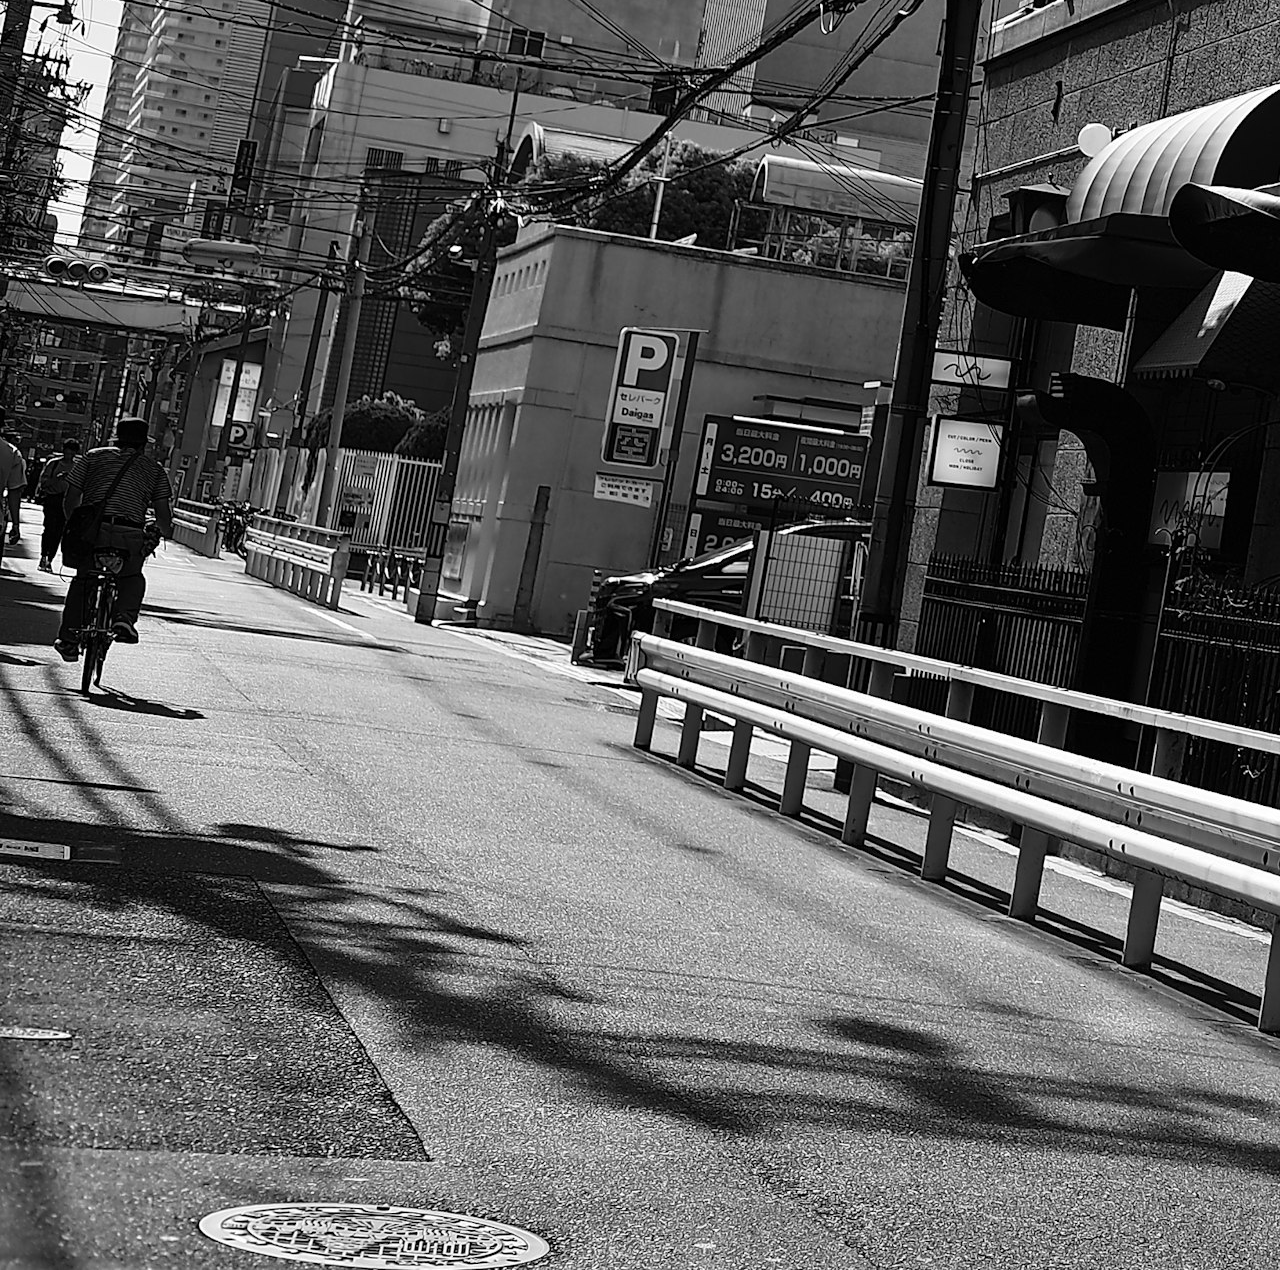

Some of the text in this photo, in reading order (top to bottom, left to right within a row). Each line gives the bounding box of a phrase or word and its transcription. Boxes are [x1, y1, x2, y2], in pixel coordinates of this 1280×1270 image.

[623, 333, 668, 386] P
[621, 407, 654, 419] Daigas
[229, 424, 245, 443] P
[720, 444, 788, 469] 3,200円
[799, 454, 862, 479] 1,000円
